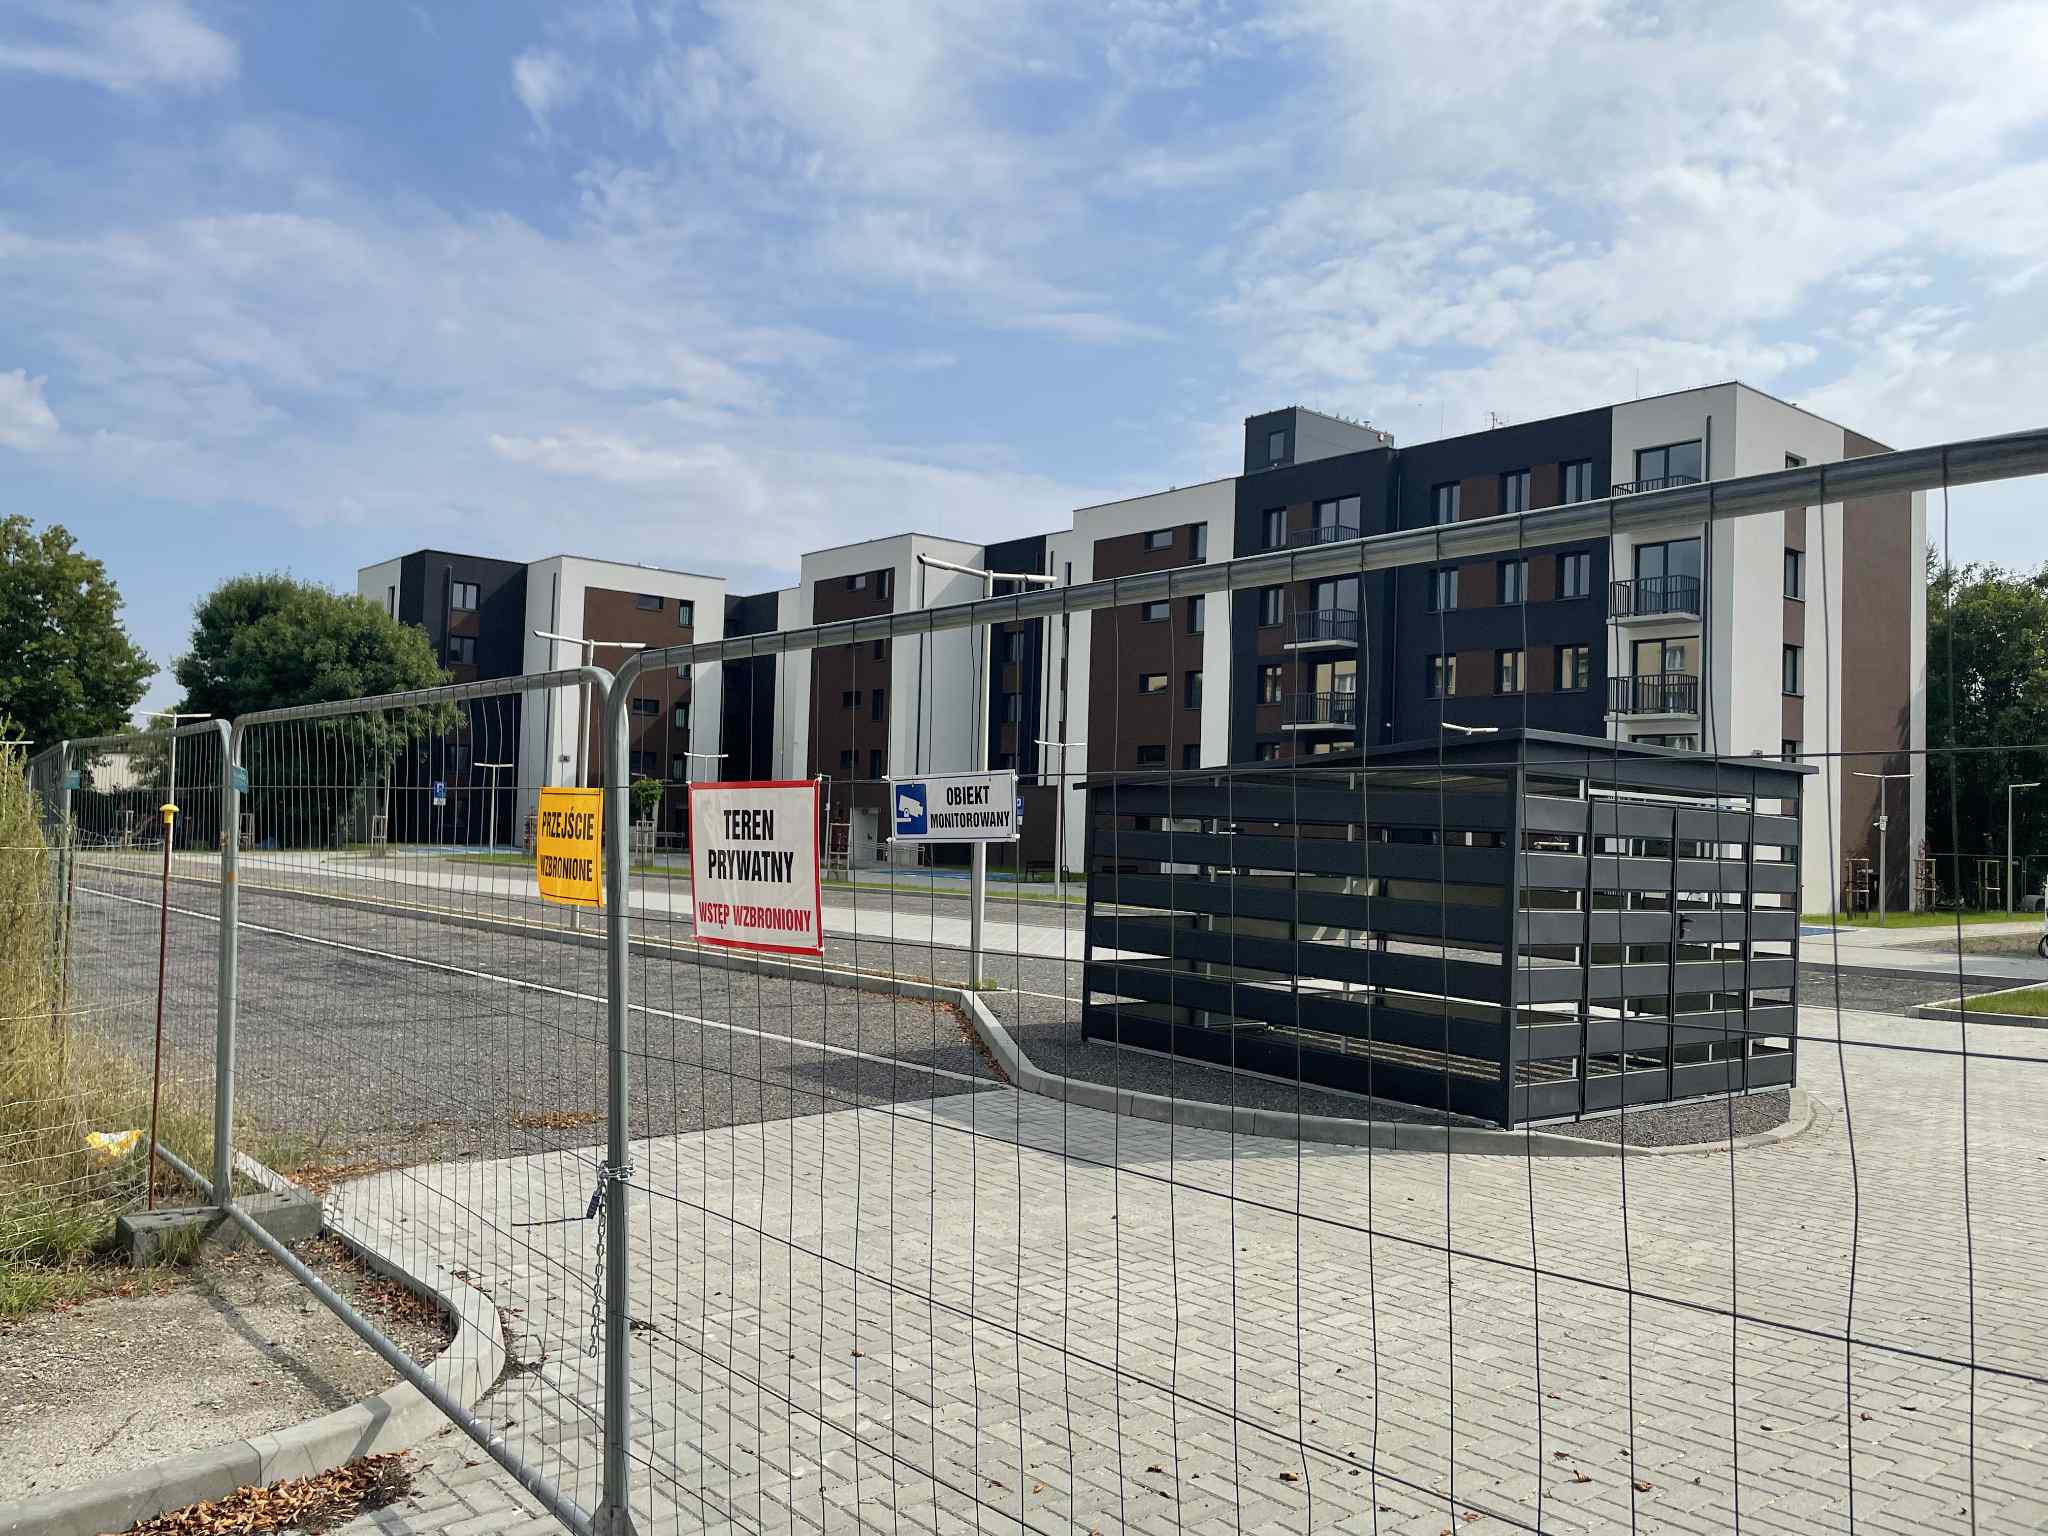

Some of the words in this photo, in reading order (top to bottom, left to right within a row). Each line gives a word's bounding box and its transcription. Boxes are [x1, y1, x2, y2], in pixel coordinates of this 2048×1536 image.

[946, 785, 990, 805] OBIEKT
[542, 806, 595, 841] PRZEJŚCIE
[723, 808, 775, 841] TEREN
[930, 810, 1010, 829] MONITOROWANY
[540, 854, 593, 882] WZBRONIONE
[708, 849, 794, 884] PRYWATNY
[698, 901, 730, 929] WSTĘP
[733, 904, 812, 932] WZBRONIONY
